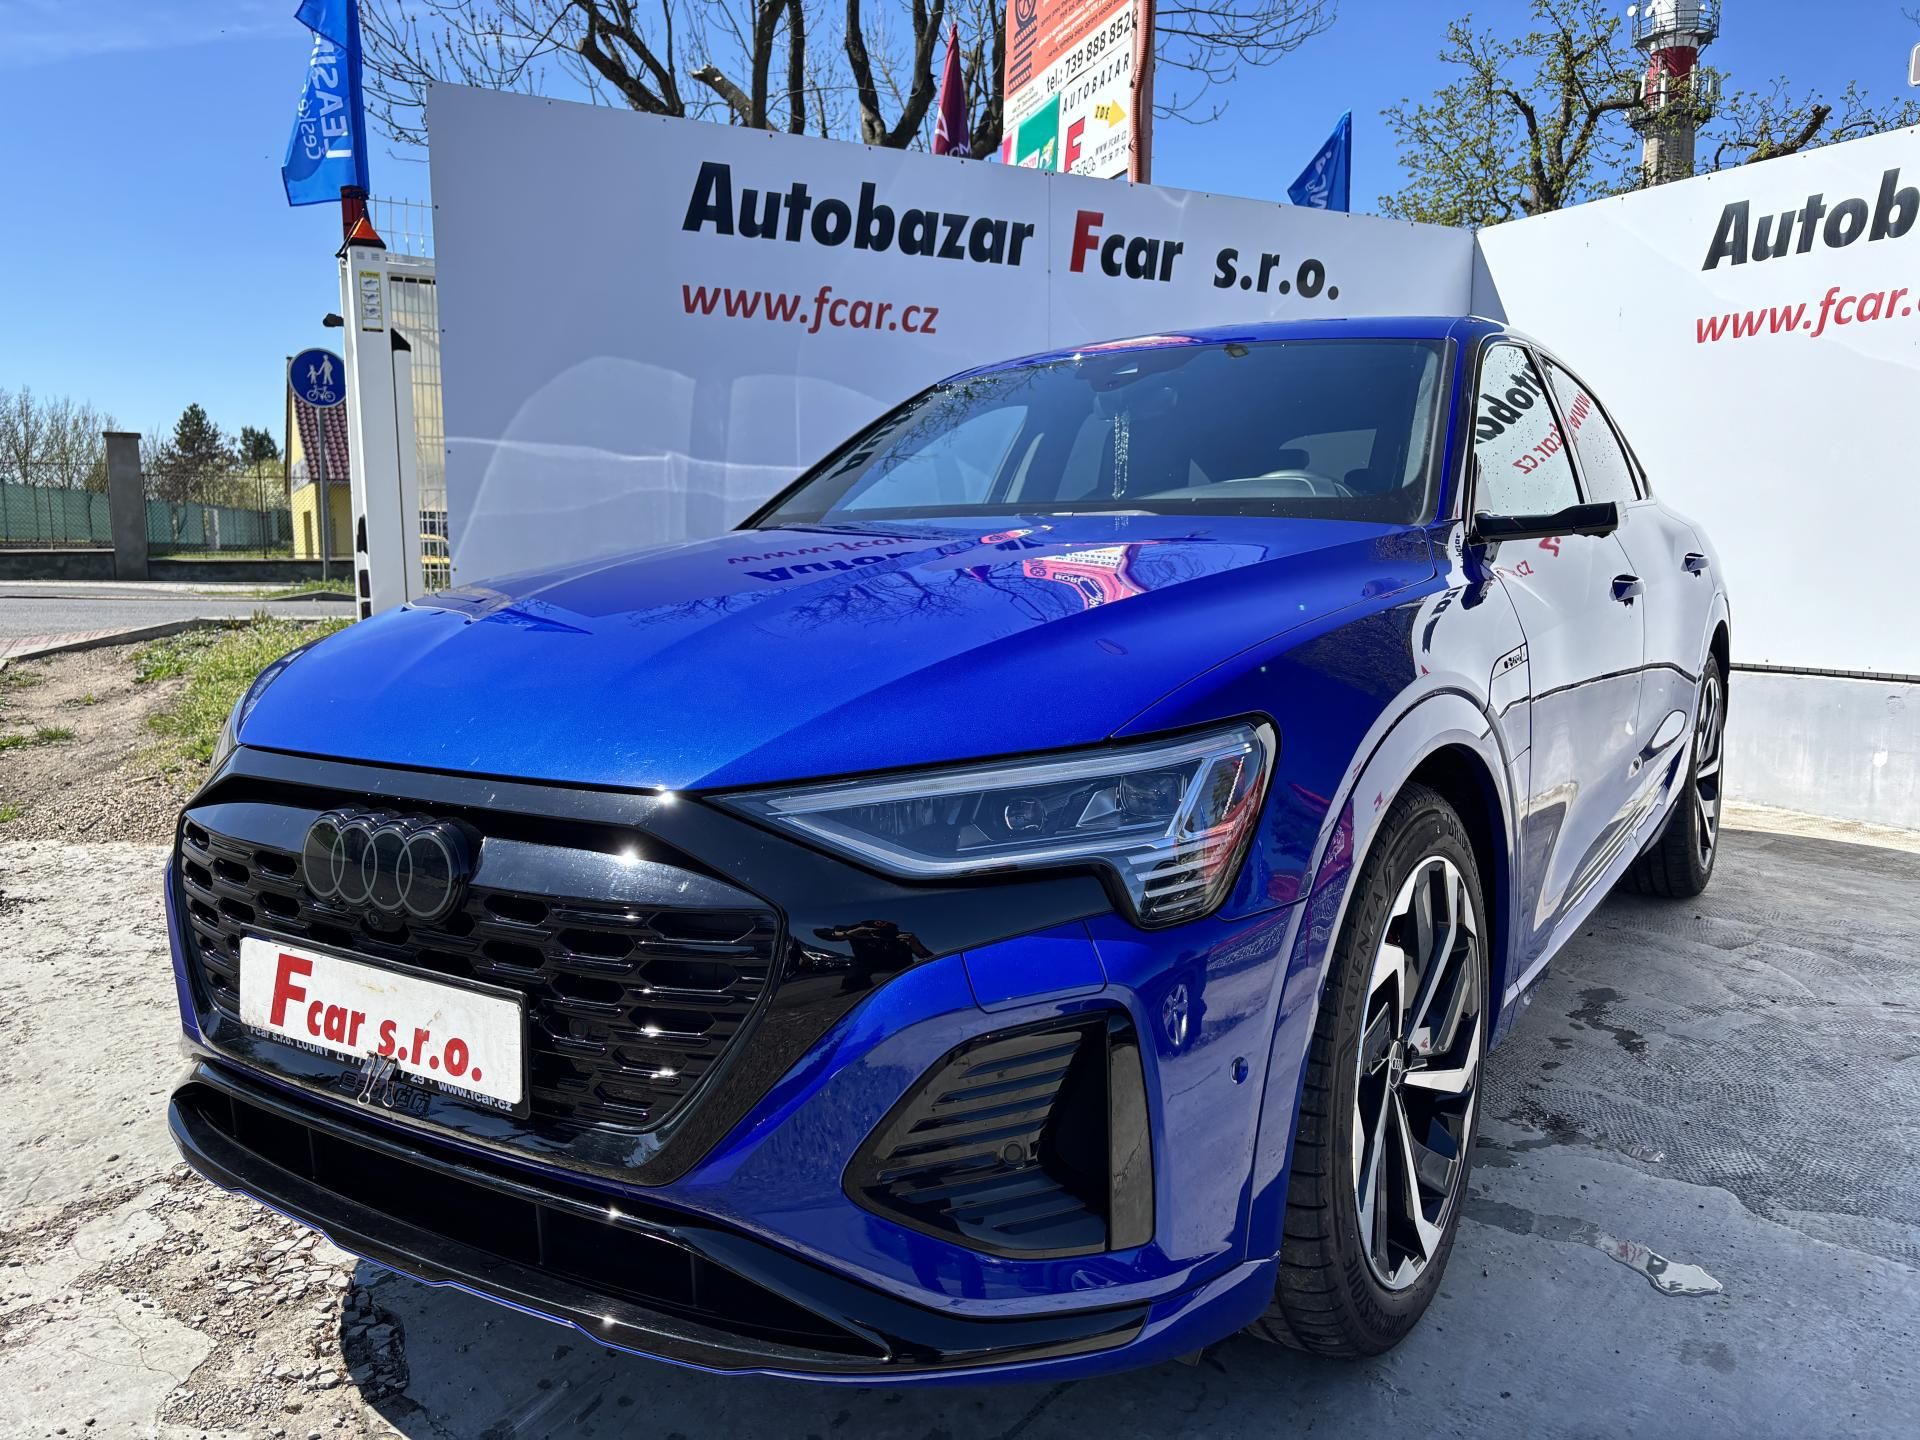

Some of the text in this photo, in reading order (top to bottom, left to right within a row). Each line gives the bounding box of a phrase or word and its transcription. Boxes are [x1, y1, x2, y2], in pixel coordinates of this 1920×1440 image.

[1046, 66, 1063, 93] tel.:
[1065, 49, 1084, 79] 739
[1086, 30, 1106, 62] 888
[682, 161, 1340, 301] Autobazar Fcar s.r.o.
[681, 283, 940, 335] www.fcar.cz
[1695, 286, 1920, 344] www.fcar.
[377, 1019, 483, 1083] s.r.o.
